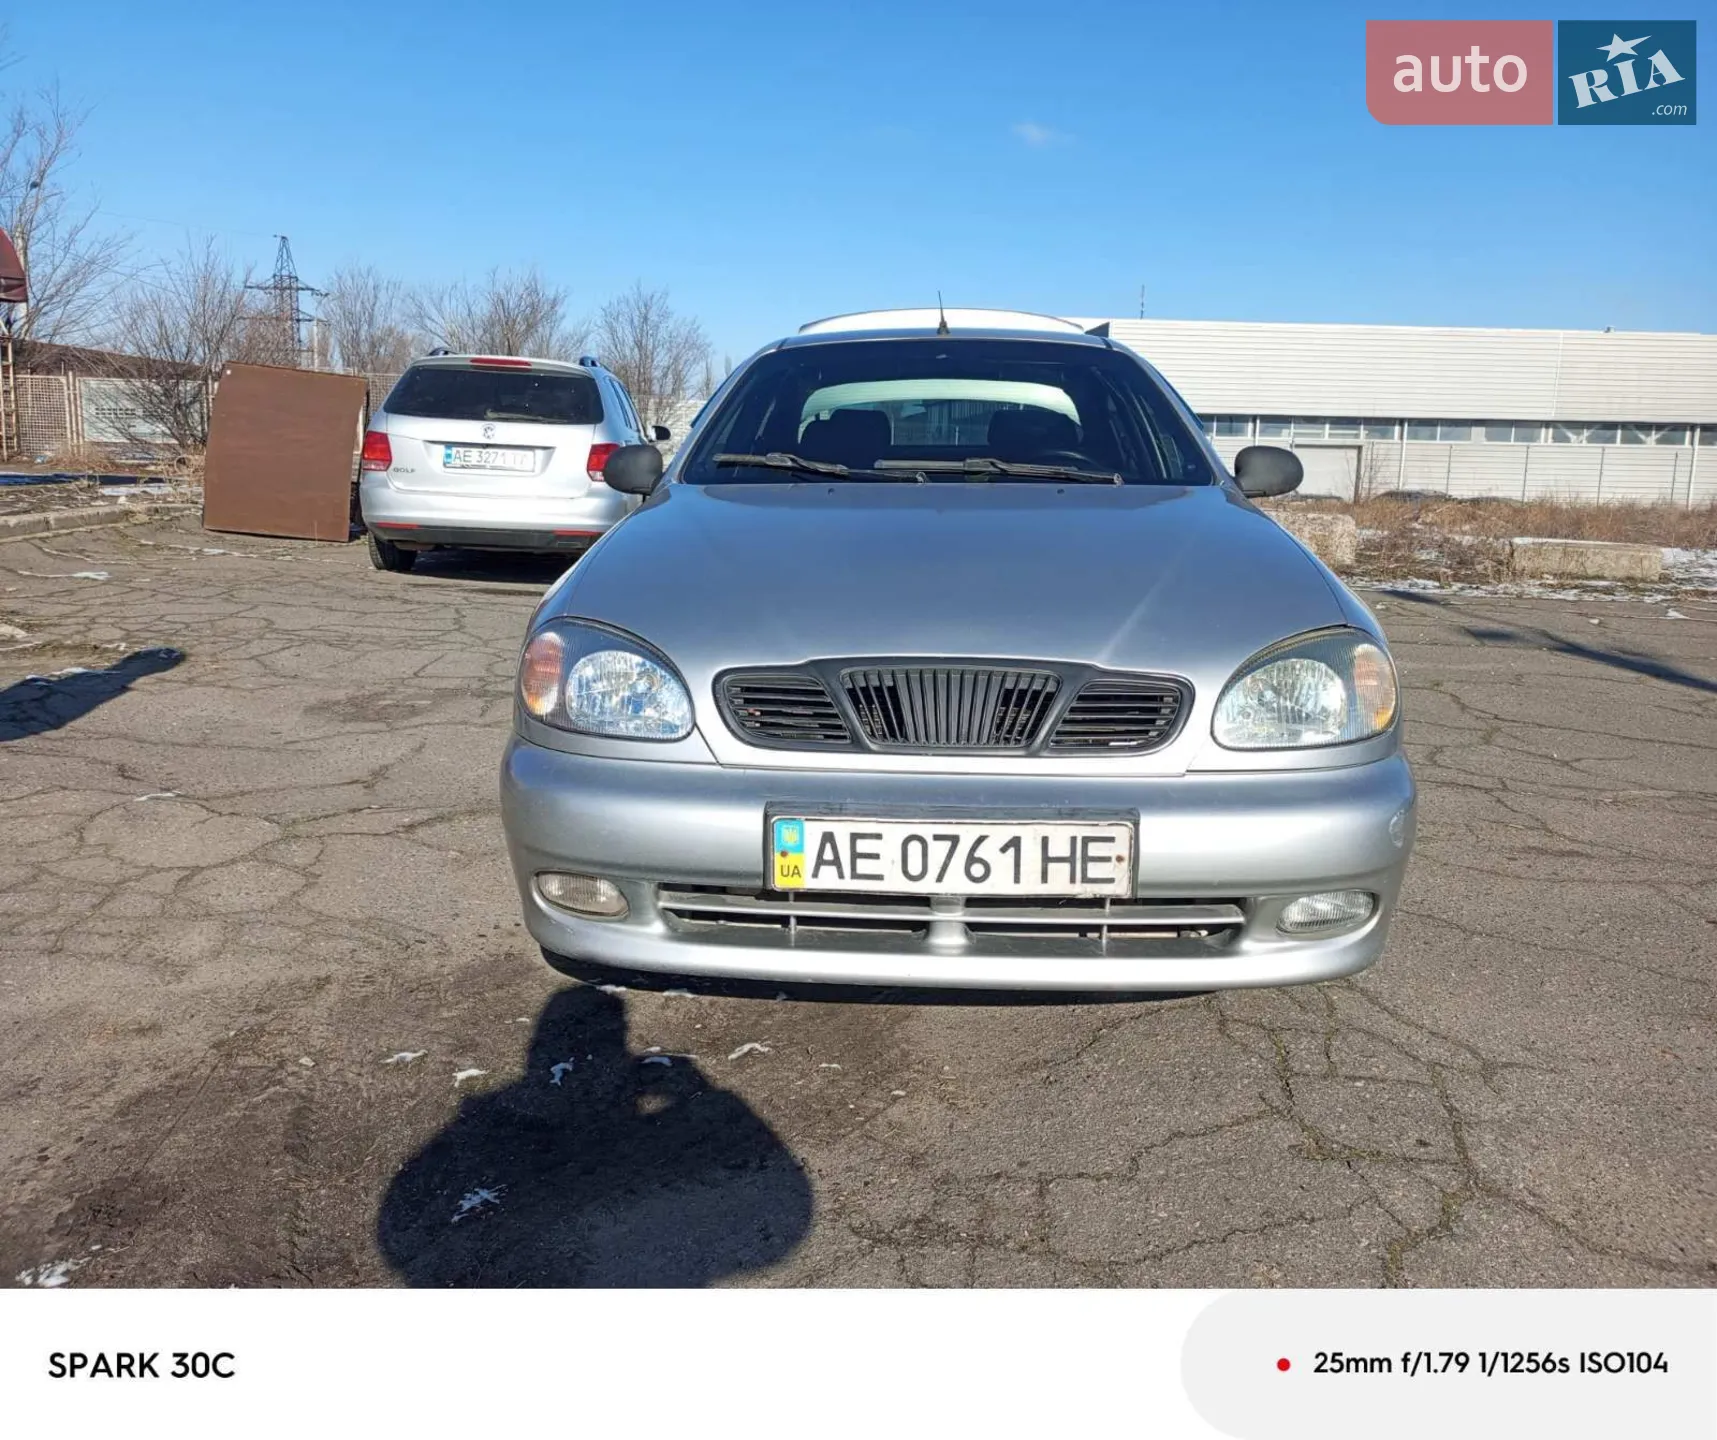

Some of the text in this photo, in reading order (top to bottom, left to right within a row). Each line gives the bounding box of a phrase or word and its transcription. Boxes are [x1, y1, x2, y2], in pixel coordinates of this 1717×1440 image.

[453, 449, 472, 463] AE
[476, 450, 506, 464] 3271
[811, 831, 1116, 885] AE 0761 HE
[780, 864, 801, 879] UA
